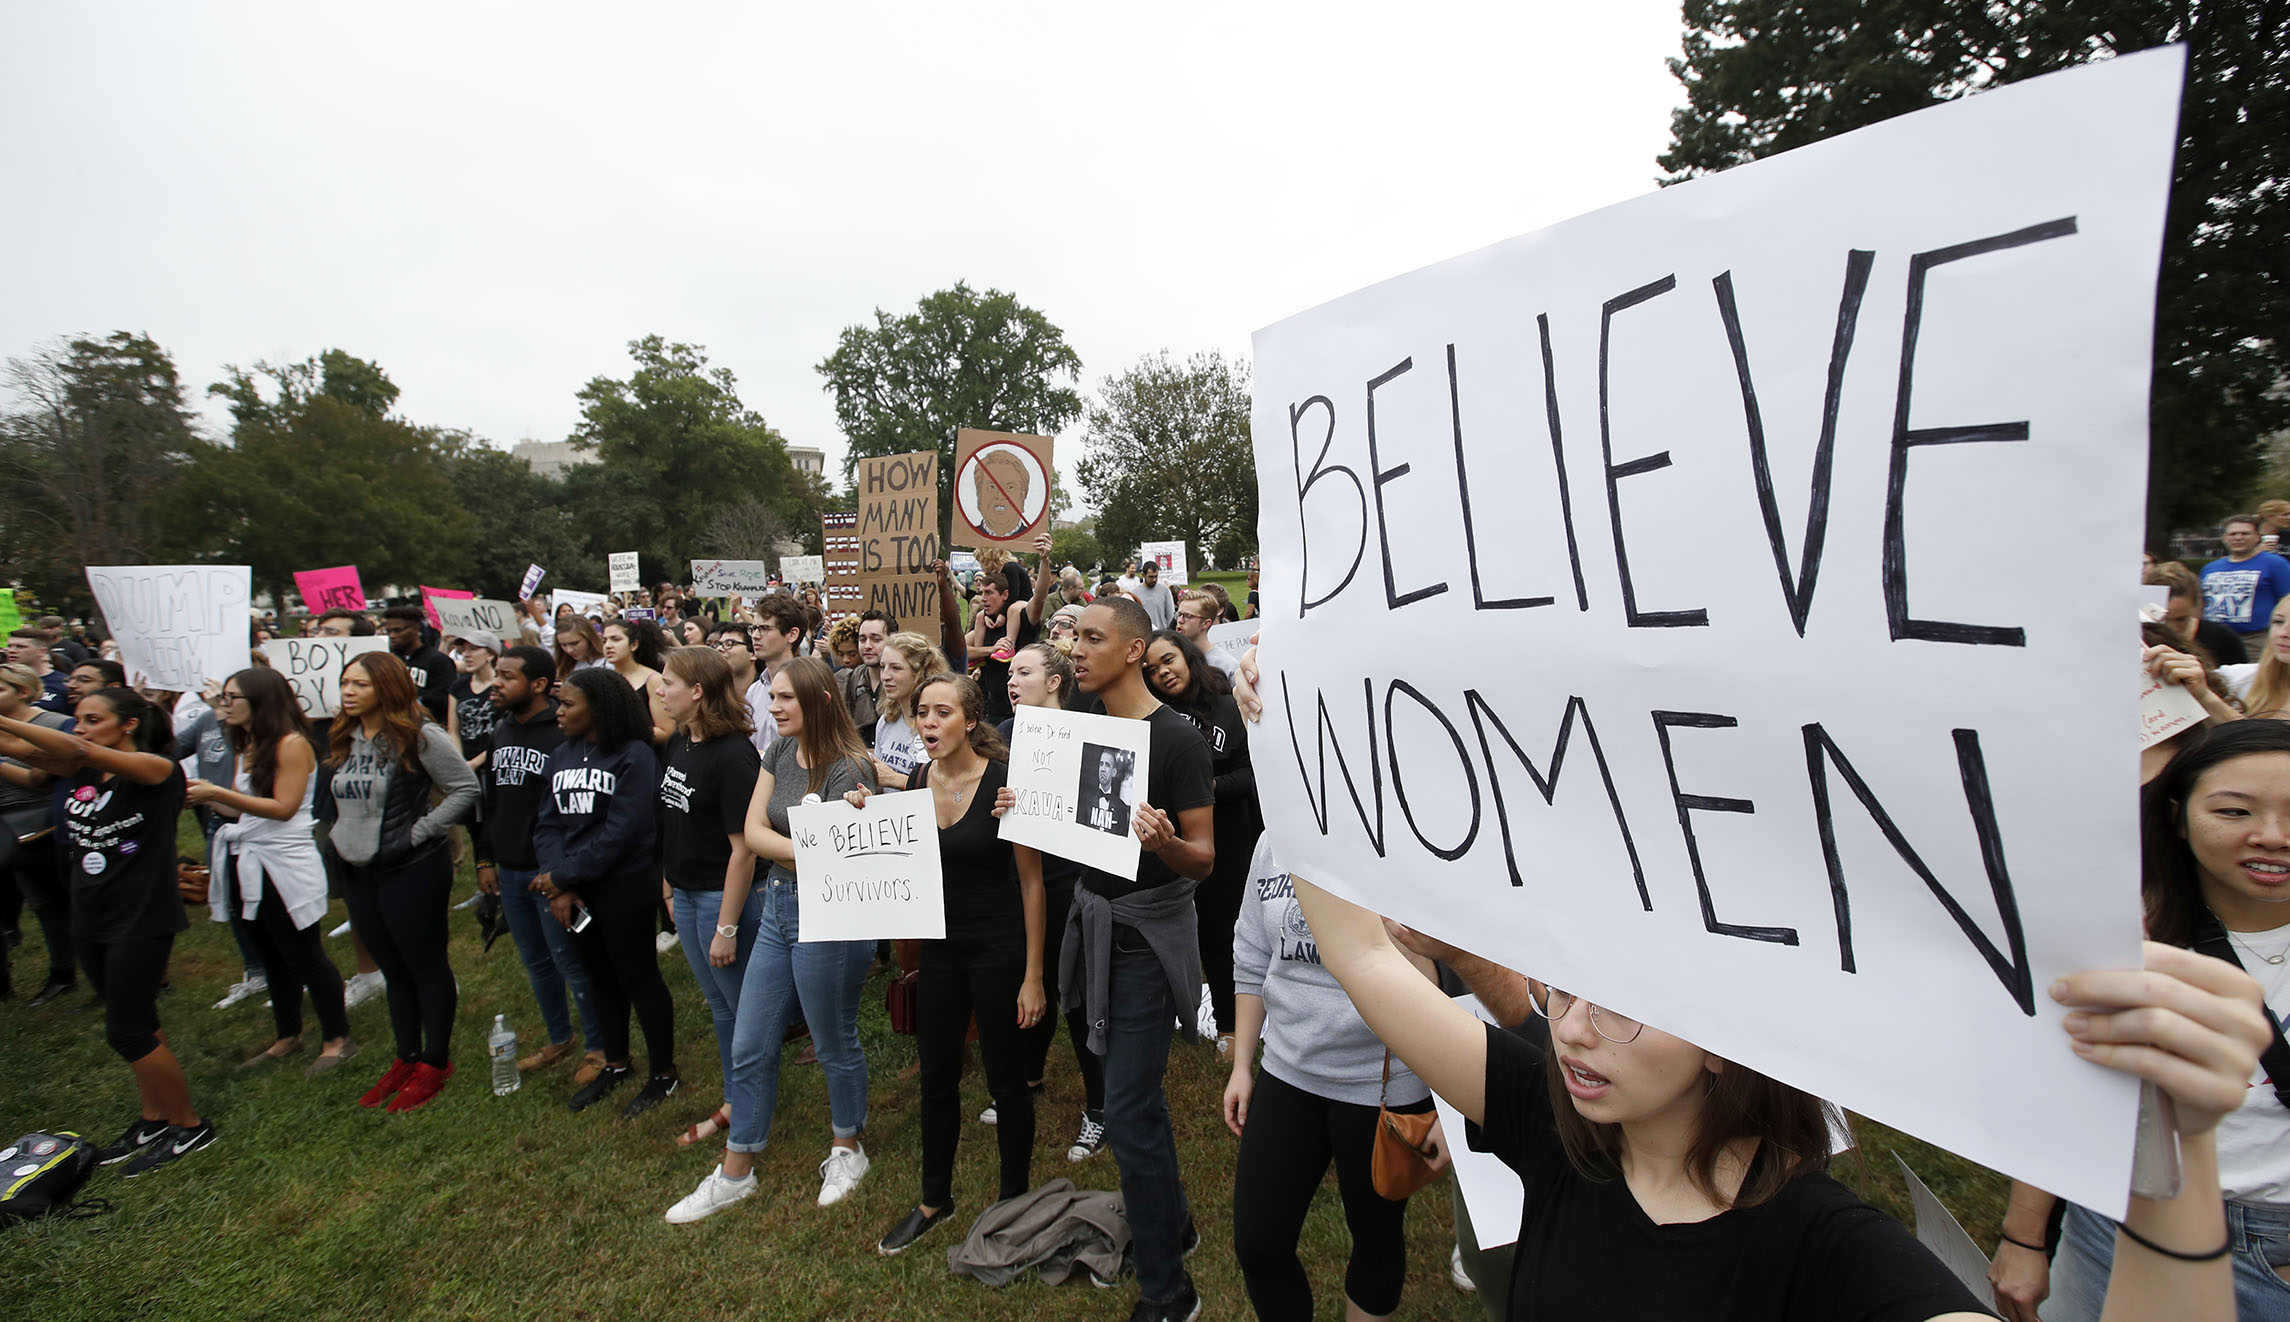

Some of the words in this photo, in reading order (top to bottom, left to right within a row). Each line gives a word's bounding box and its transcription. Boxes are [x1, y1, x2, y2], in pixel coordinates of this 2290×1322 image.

[1289, 216, 2078, 647] BELIEVE
[868, 455, 933, 493] HOW
[823, 512, 857, 530] HOW
[862, 497, 928, 535] MANY
[862, 538, 883, 573] IS
[890, 532, 938, 575] TOO
[93, 570, 248, 634] DUMP
[319, 586, 362, 609] HER
[870, 581, 937, 618] MANY?
[287, 640, 347, 675] BOY
[1058, 726, 1071, 740] Ford
[881, 752, 907, 768] HAT'S
[895, 742, 910, 755] AM
[1032, 749, 1054, 765] NOT
[333, 779, 372, 800] LAW
[495, 768, 526, 786] LAW
[554, 791, 596, 815] LAW
[1012, 787, 1063, 822] KAVA
[795, 828, 818, 849] We
[829, 814, 919, 853] BELIEVE
[1281, 669, 2036, 1017] WOMEN
[822, 873, 919, 903] Survivors.
[1280, 936, 1321, 965] LAW
